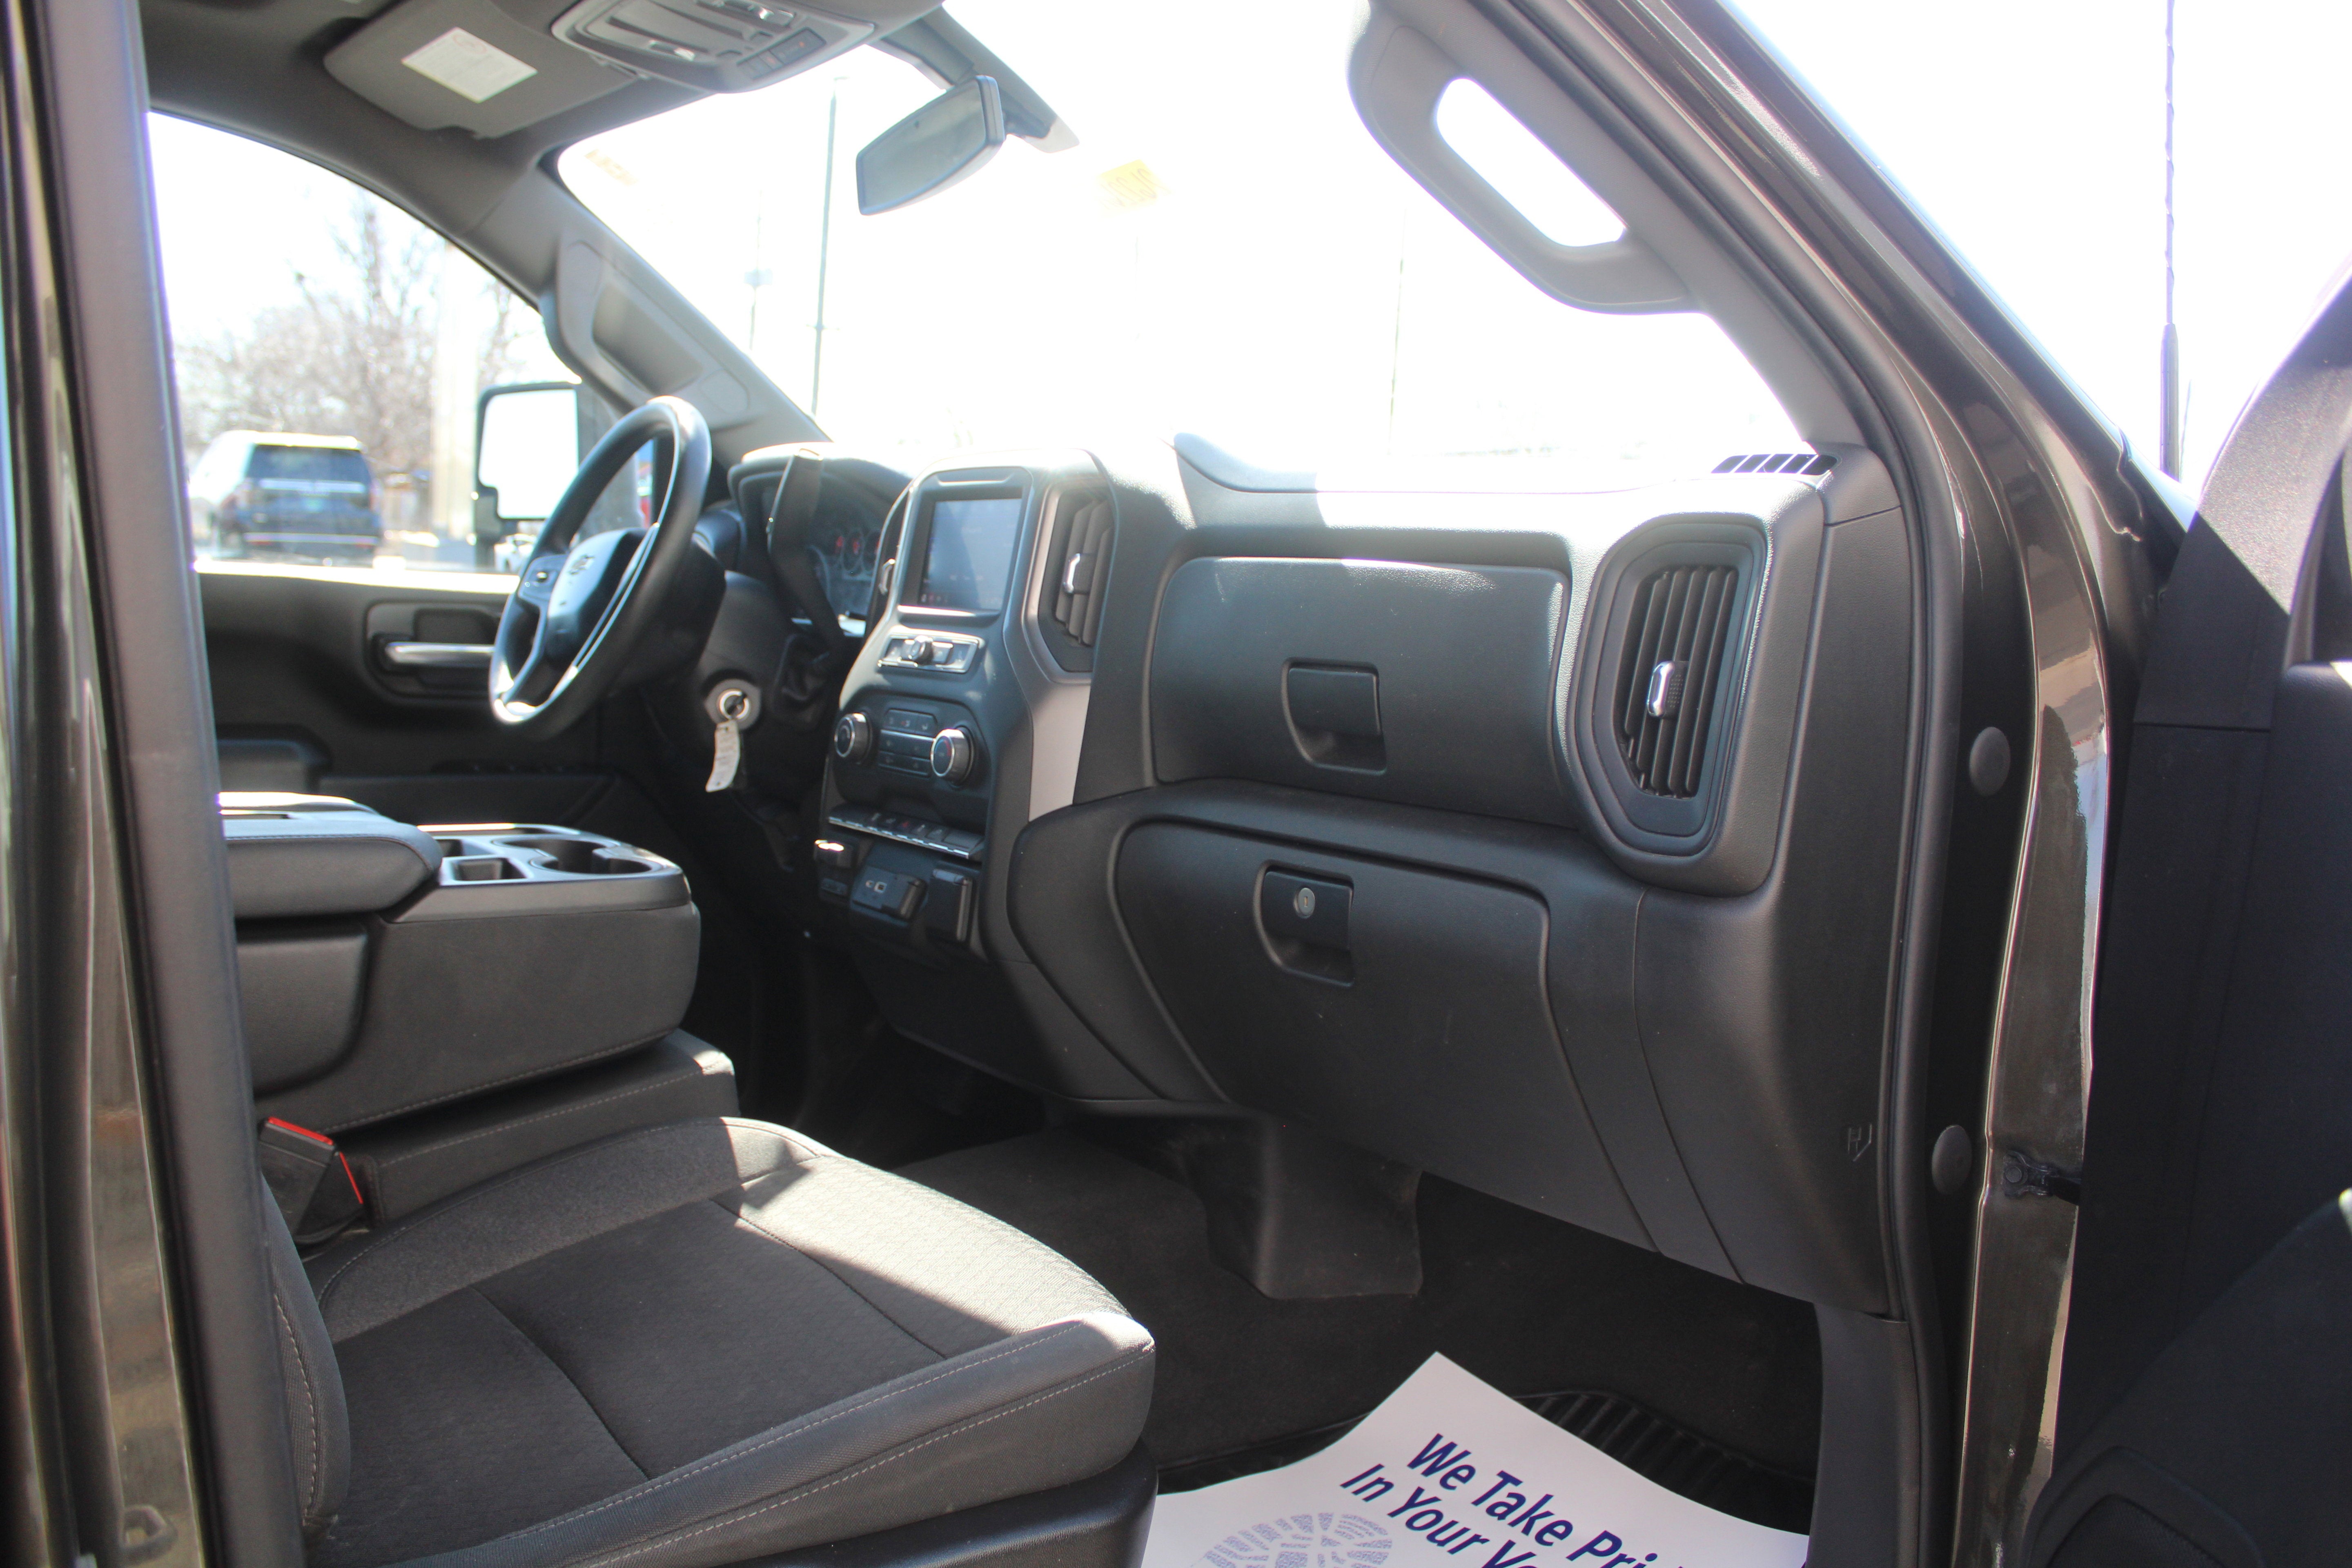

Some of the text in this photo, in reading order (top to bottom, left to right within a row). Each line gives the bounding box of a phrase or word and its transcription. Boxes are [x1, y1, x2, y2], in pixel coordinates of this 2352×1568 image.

[1340, 1463, 1394, 1502] In
[1387, 1486, 1490, 1555] Your
[1407, 1433, 1682, 1568] We Take Pri
